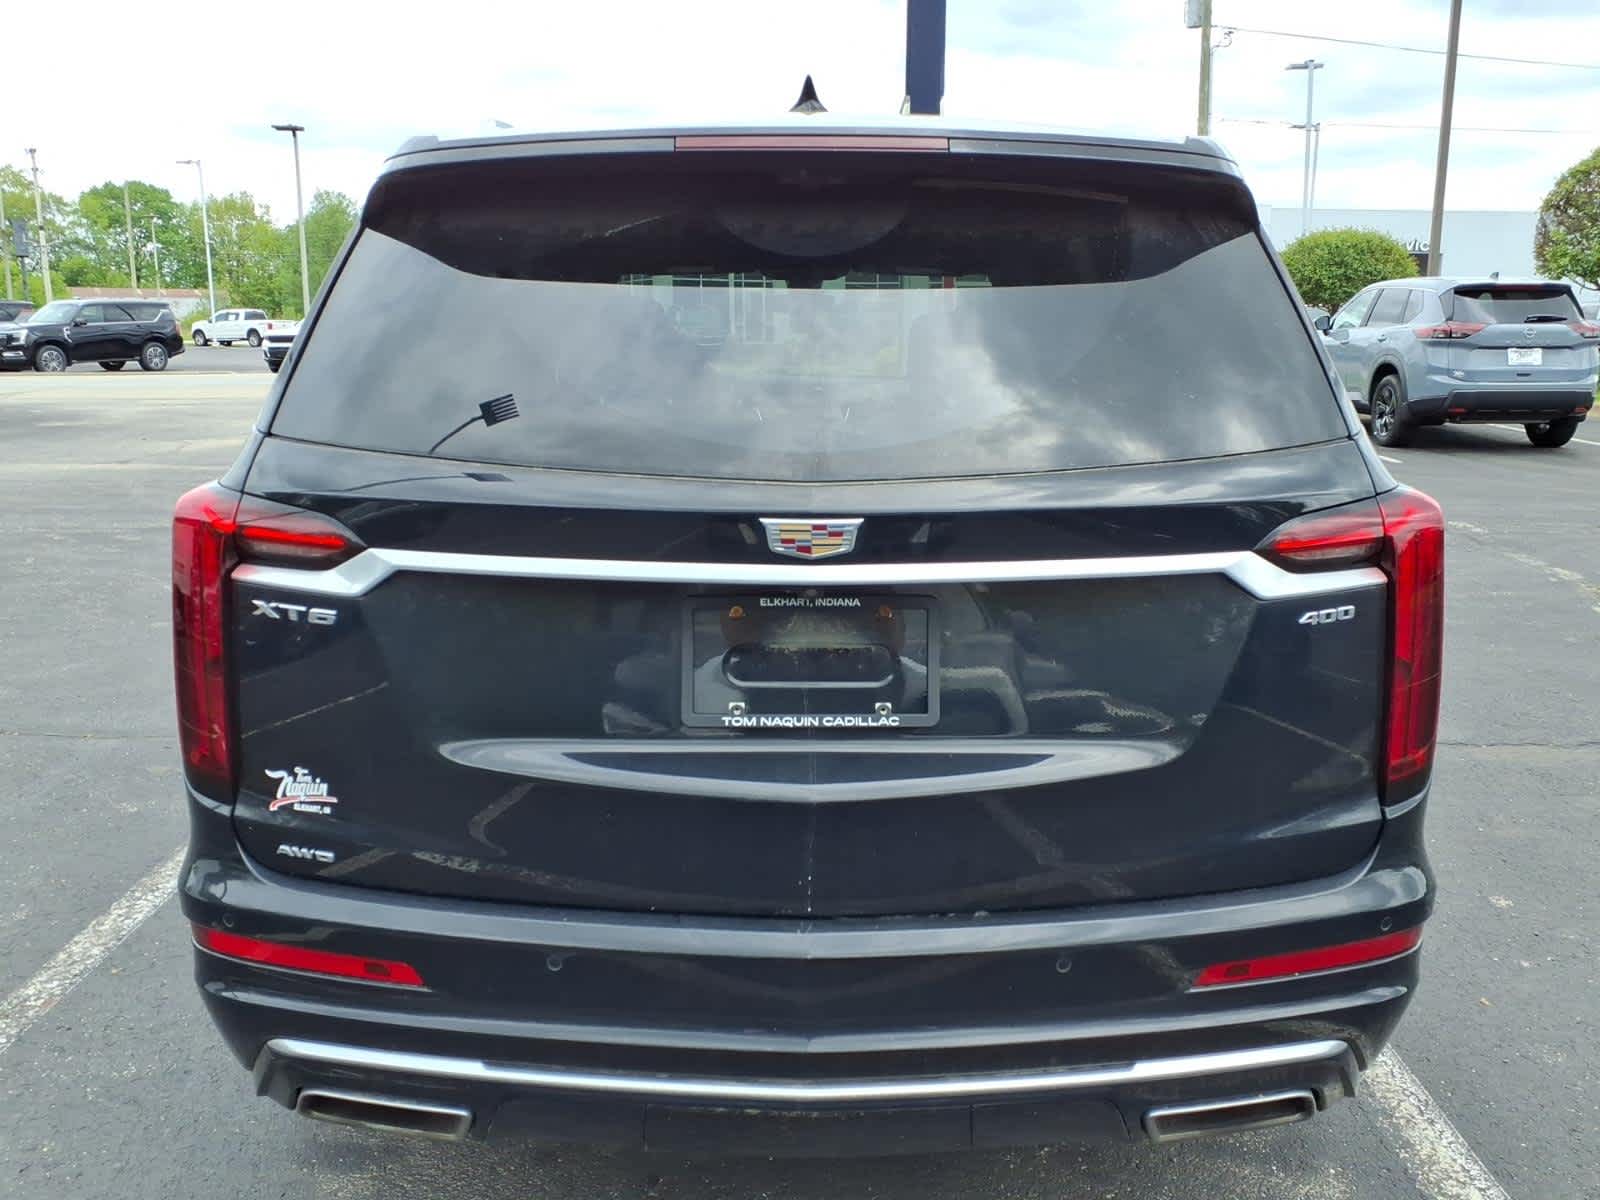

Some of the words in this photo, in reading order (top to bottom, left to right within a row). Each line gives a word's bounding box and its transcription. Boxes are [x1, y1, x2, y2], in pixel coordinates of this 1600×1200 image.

[251, 599, 338, 625] XT6
[759, 597, 813, 608] ELKHART,
[815, 597, 862, 607] INDIANA
[1298, 605, 1355, 625] 400
[721, 716, 757, 727] TOM
[760, 716, 819, 728] NAQUIN
[822, 716, 900, 727] CADILLAC
[264, 769, 329, 801] Naquin
[276, 844, 336, 863] AWD
